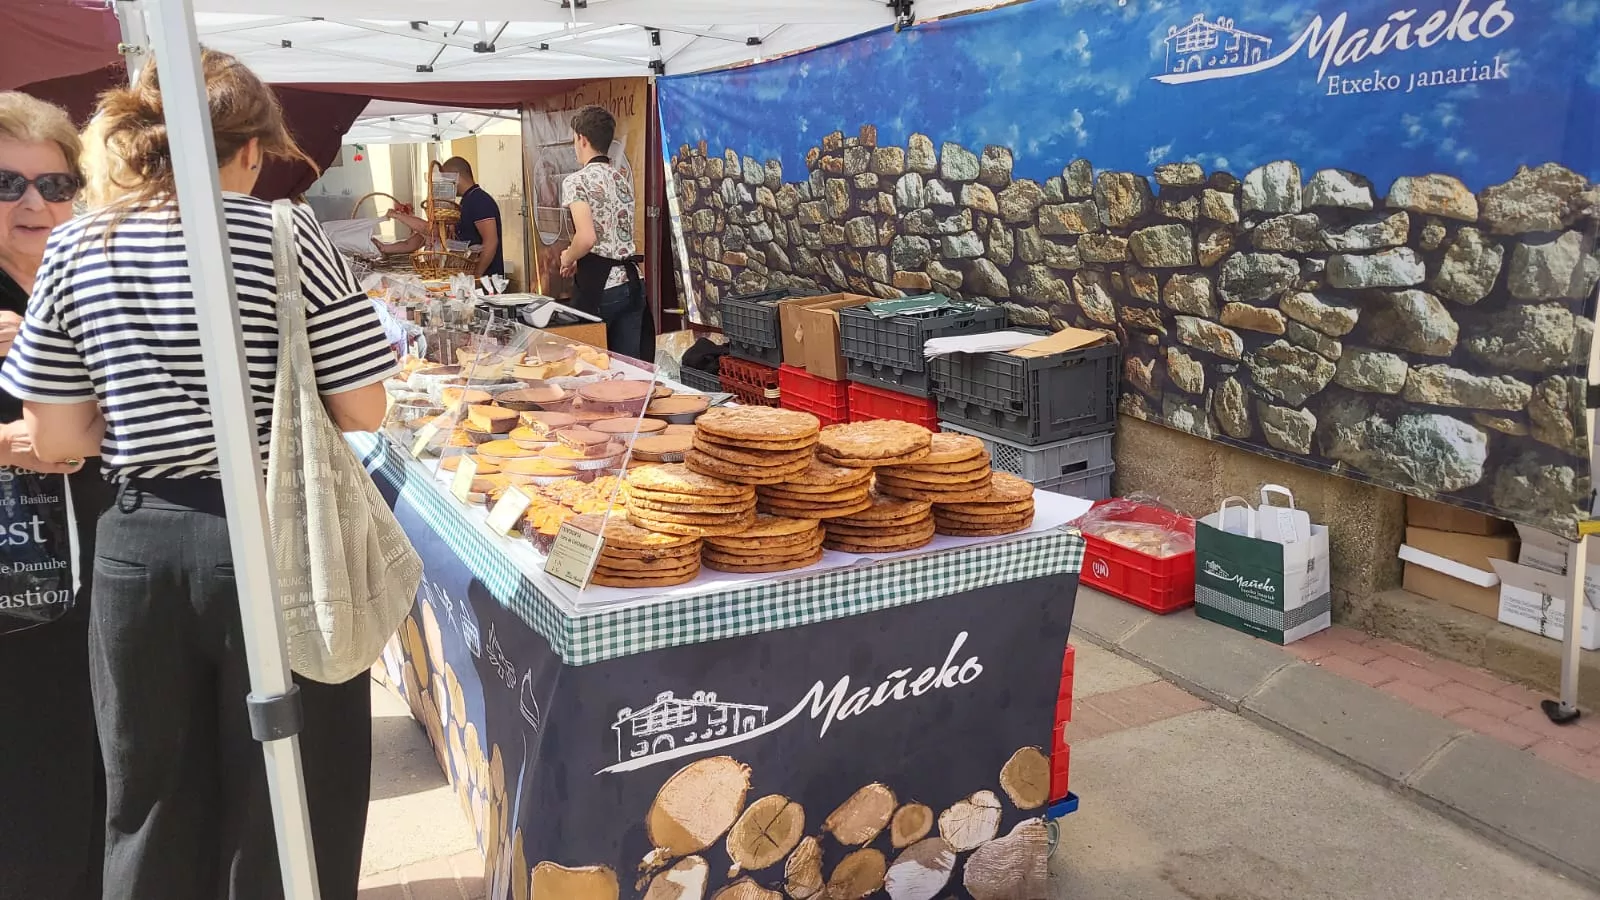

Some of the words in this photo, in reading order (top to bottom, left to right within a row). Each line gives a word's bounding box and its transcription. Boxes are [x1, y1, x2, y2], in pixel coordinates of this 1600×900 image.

[1300, 0, 1514, 83] Mañeko
[1326, 72, 1400, 96] Etxeko
[20, 494, 60, 505] Basilica
[13, 557, 68, 573] Danube
[801, 631, 984, 740] Mañeko
